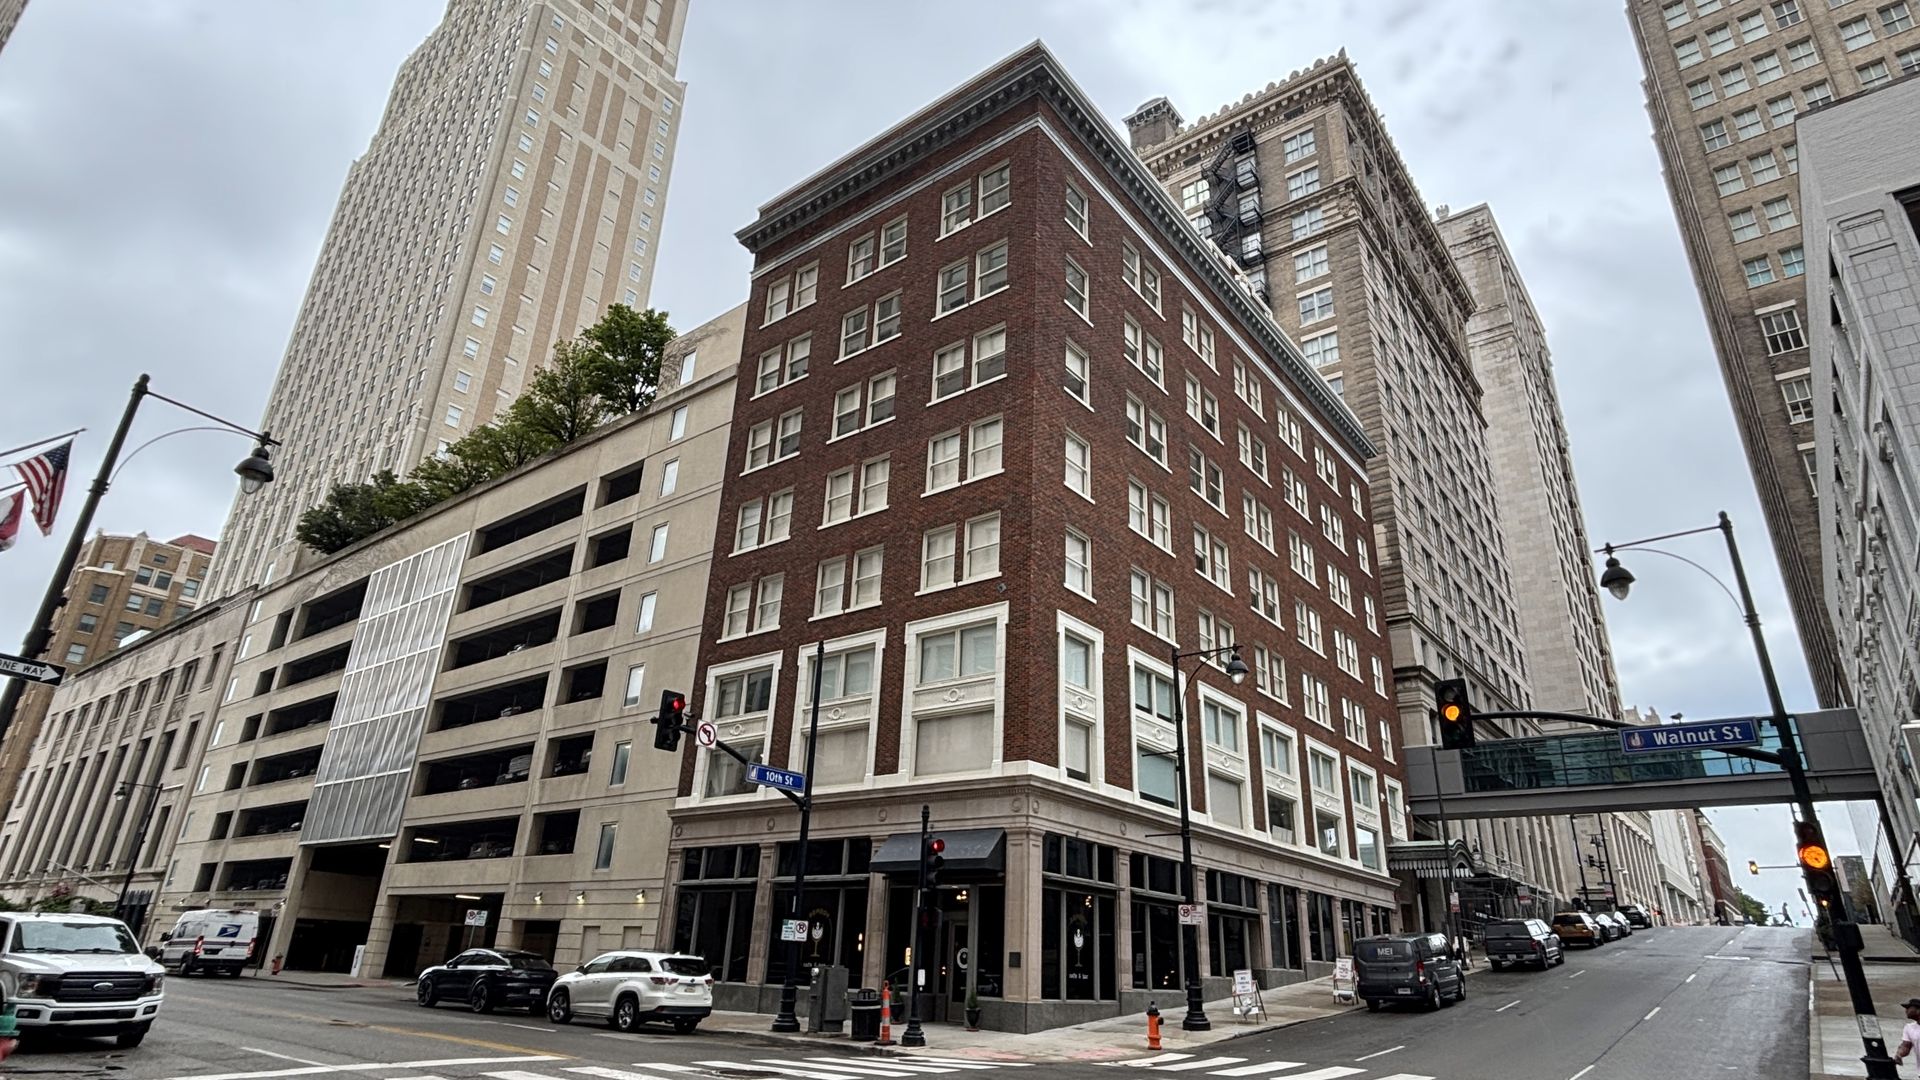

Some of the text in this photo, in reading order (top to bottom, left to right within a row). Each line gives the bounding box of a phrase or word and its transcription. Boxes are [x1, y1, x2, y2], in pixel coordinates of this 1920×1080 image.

[23, 665, 47, 676] WAY
[1653, 726, 1742, 745] Walnut St
[766, 771, 793, 786] 10th St
[1377, 947, 1393, 956] MEI
